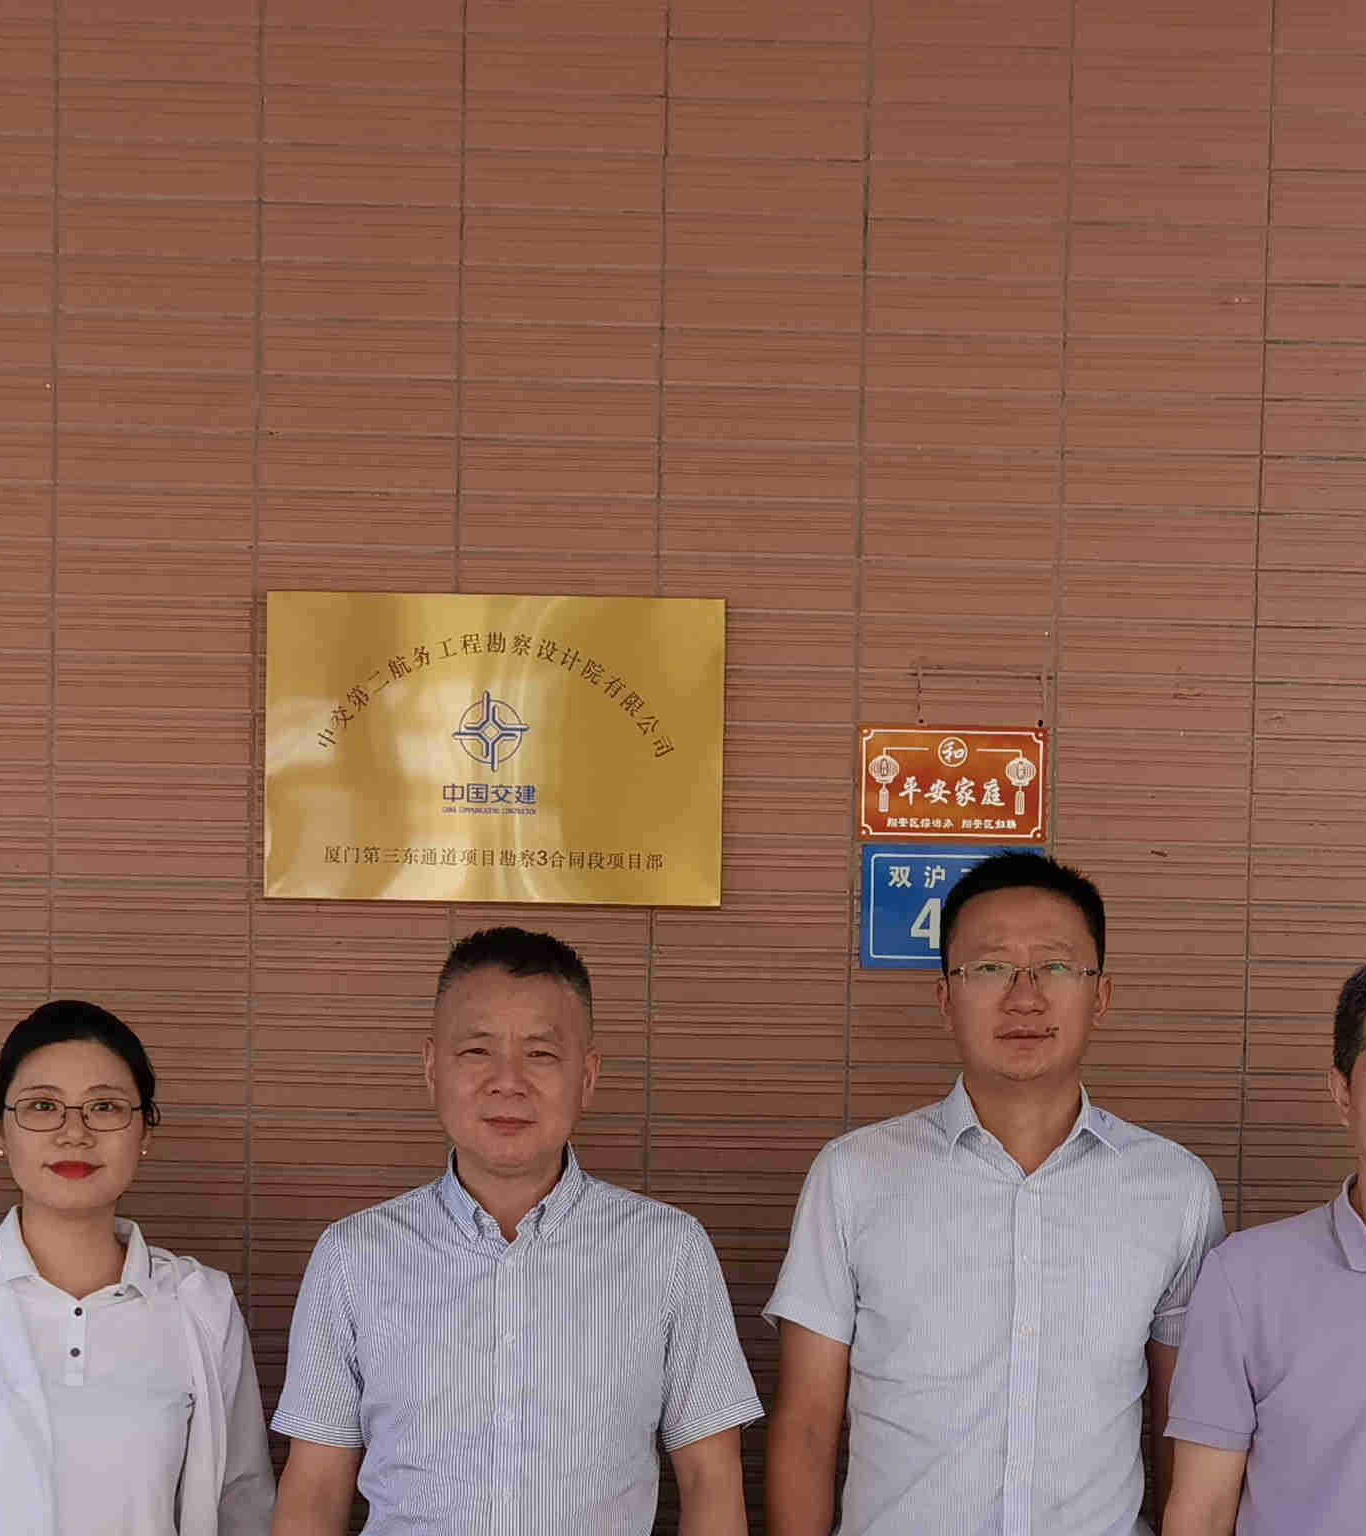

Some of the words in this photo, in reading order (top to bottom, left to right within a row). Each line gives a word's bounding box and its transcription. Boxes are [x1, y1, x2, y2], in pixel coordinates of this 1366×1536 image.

[317, 632, 675, 758] 中交第二航务工程勘察设计院有限公司
[443, 783, 536, 804] 中国交建
[898, 775, 1006, 807] 平安家庭
[323, 845, 664, 871] 厦门第三东通道项目勘察3合同段项目部
[889, 865, 972, 888] 双沪
